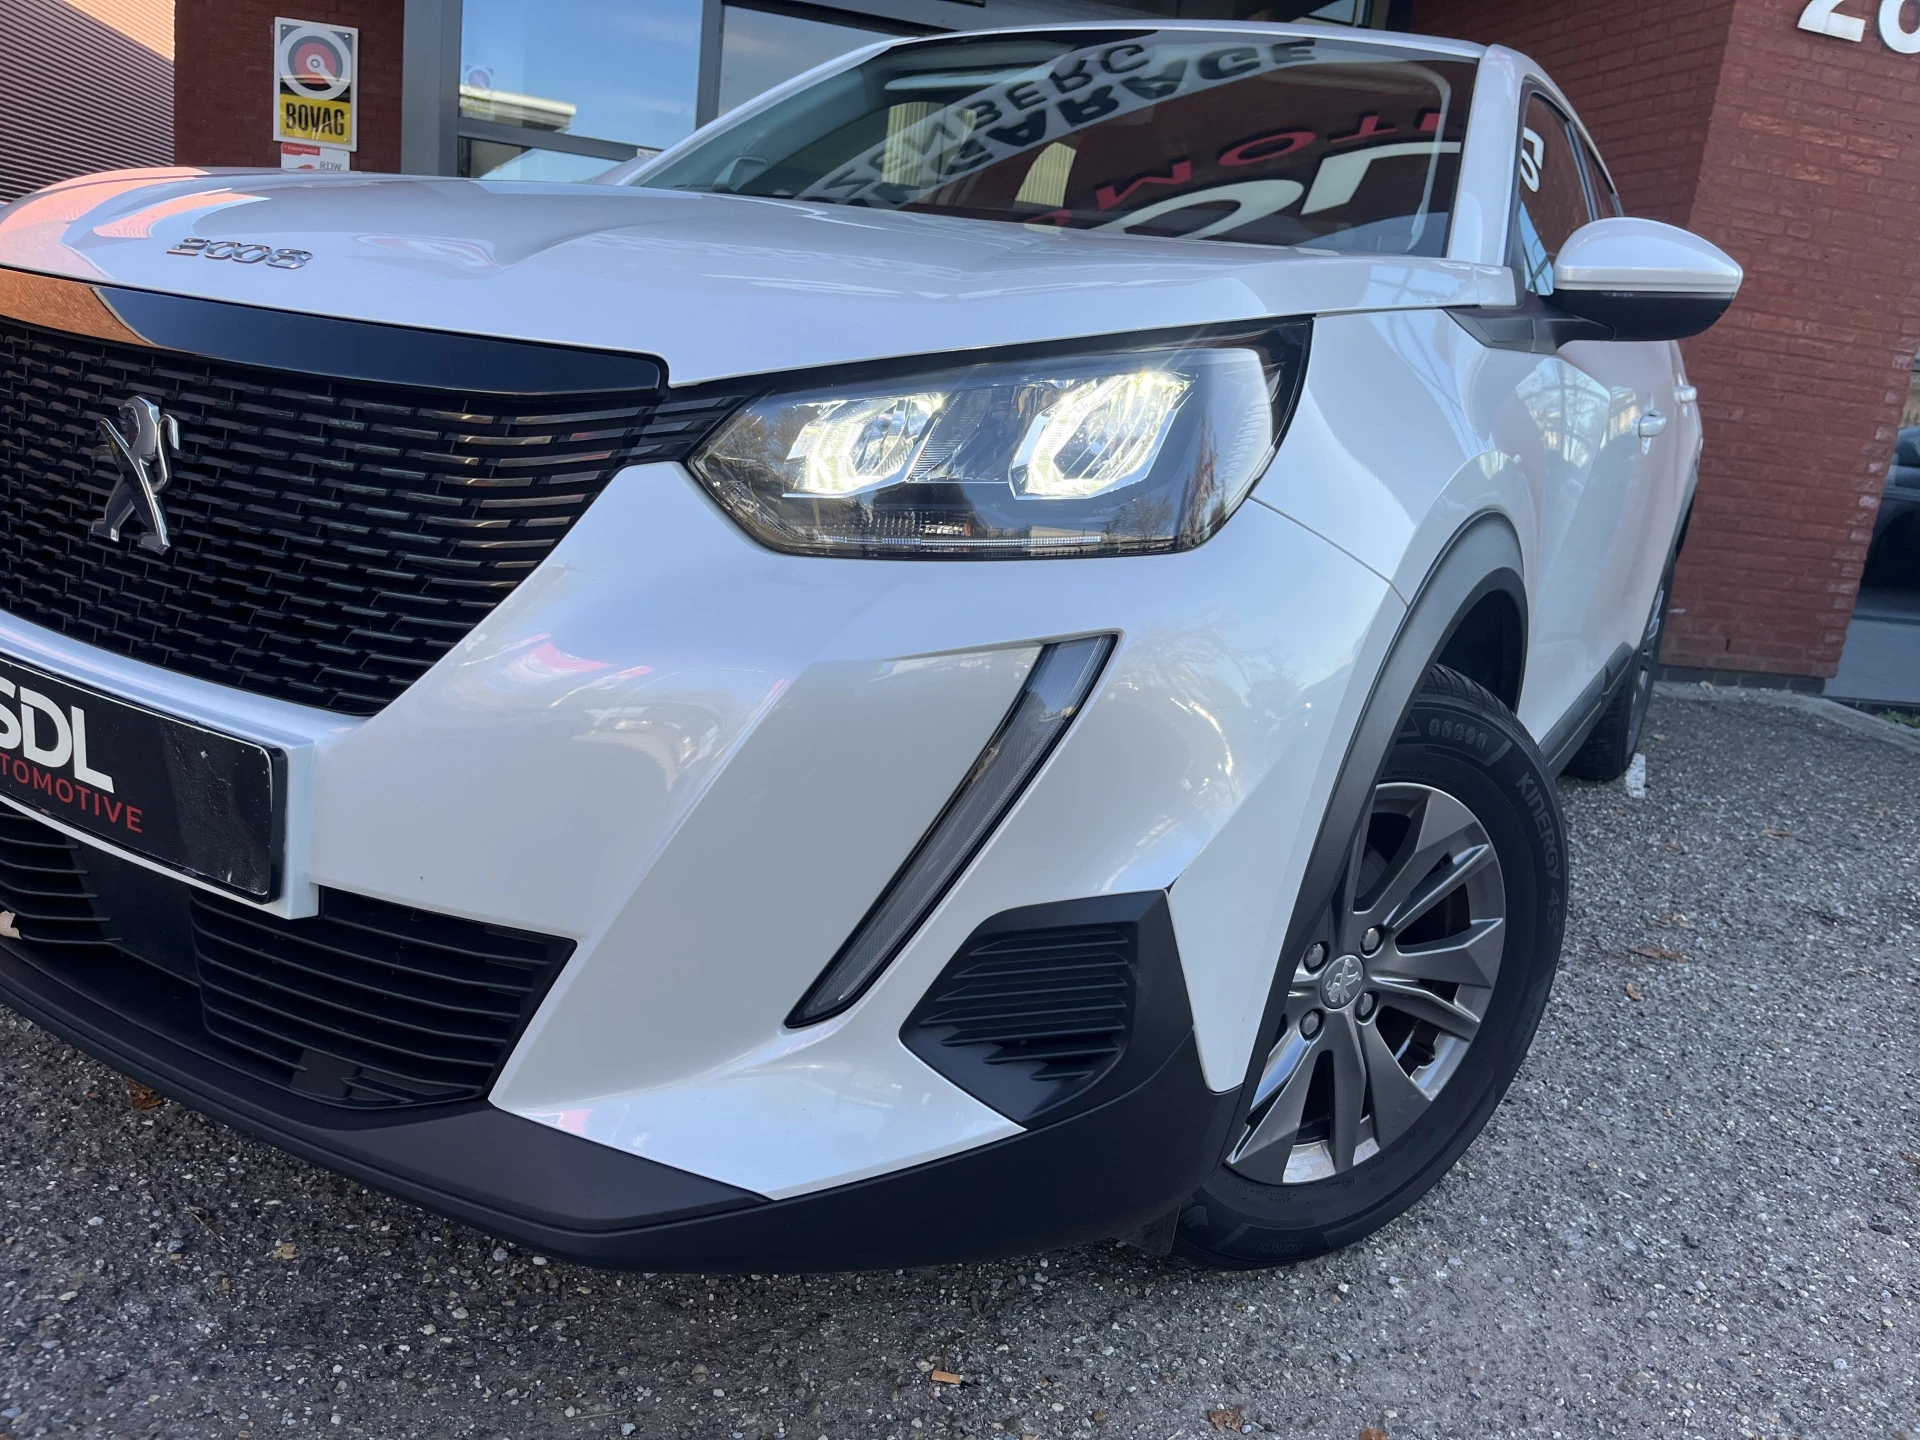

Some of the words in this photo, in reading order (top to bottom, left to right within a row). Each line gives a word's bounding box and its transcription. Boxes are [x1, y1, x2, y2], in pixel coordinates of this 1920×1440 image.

[286, 103, 344, 136] BOVAG
[166, 238, 313, 269] 2008
[1515, 771, 1560, 880] KINERGY
